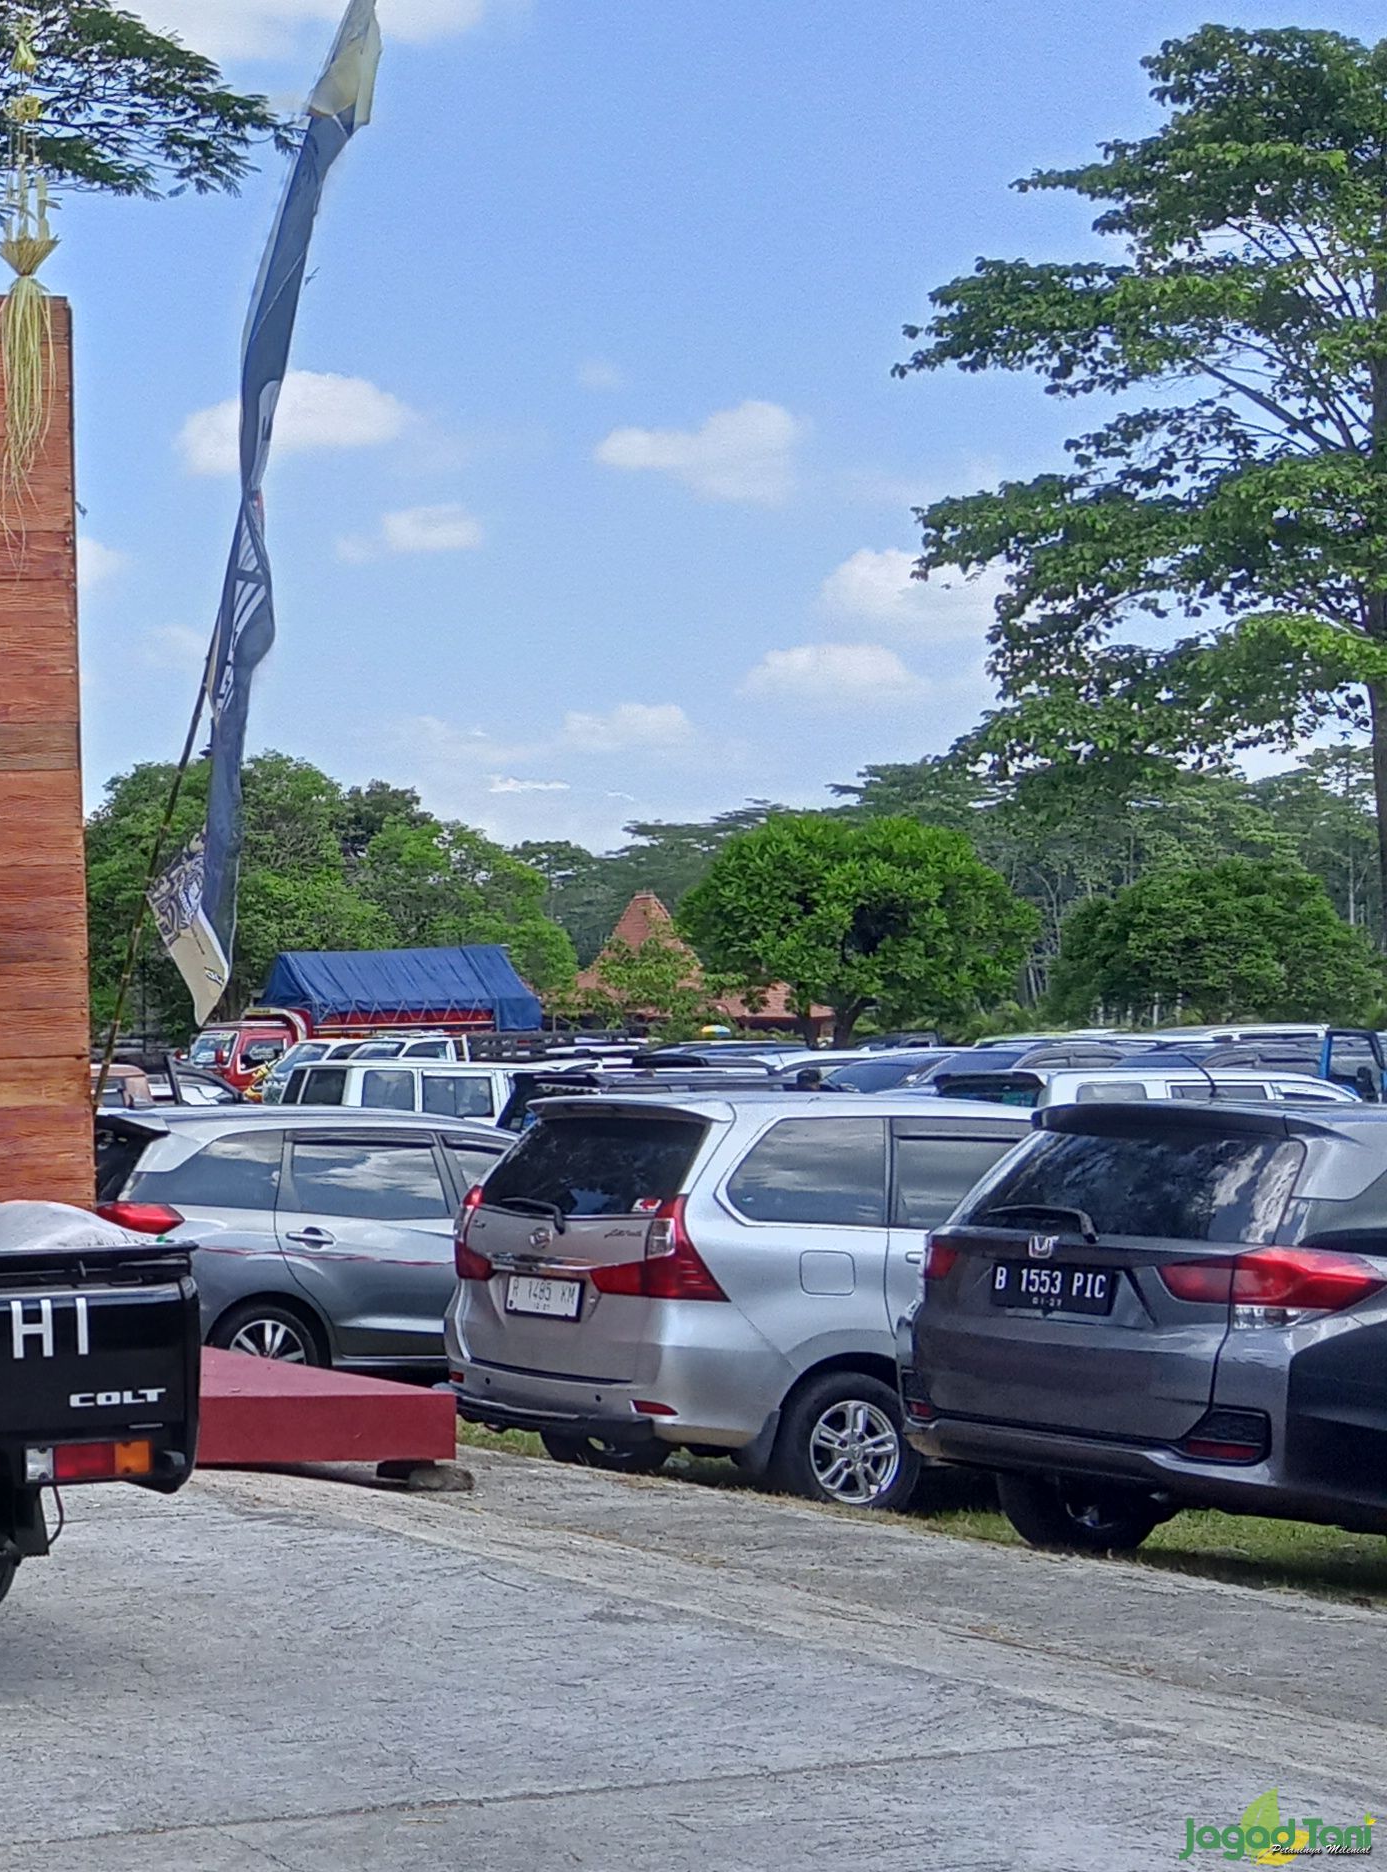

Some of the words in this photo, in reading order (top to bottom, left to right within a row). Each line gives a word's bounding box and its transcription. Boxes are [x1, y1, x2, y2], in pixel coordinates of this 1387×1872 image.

[994, 1266, 1007, 1290] B
[1020, 1268, 1062, 1294] 1553
[1071, 1272, 1107, 1299] PIC
[69, 1387, 167, 1408] COLT
